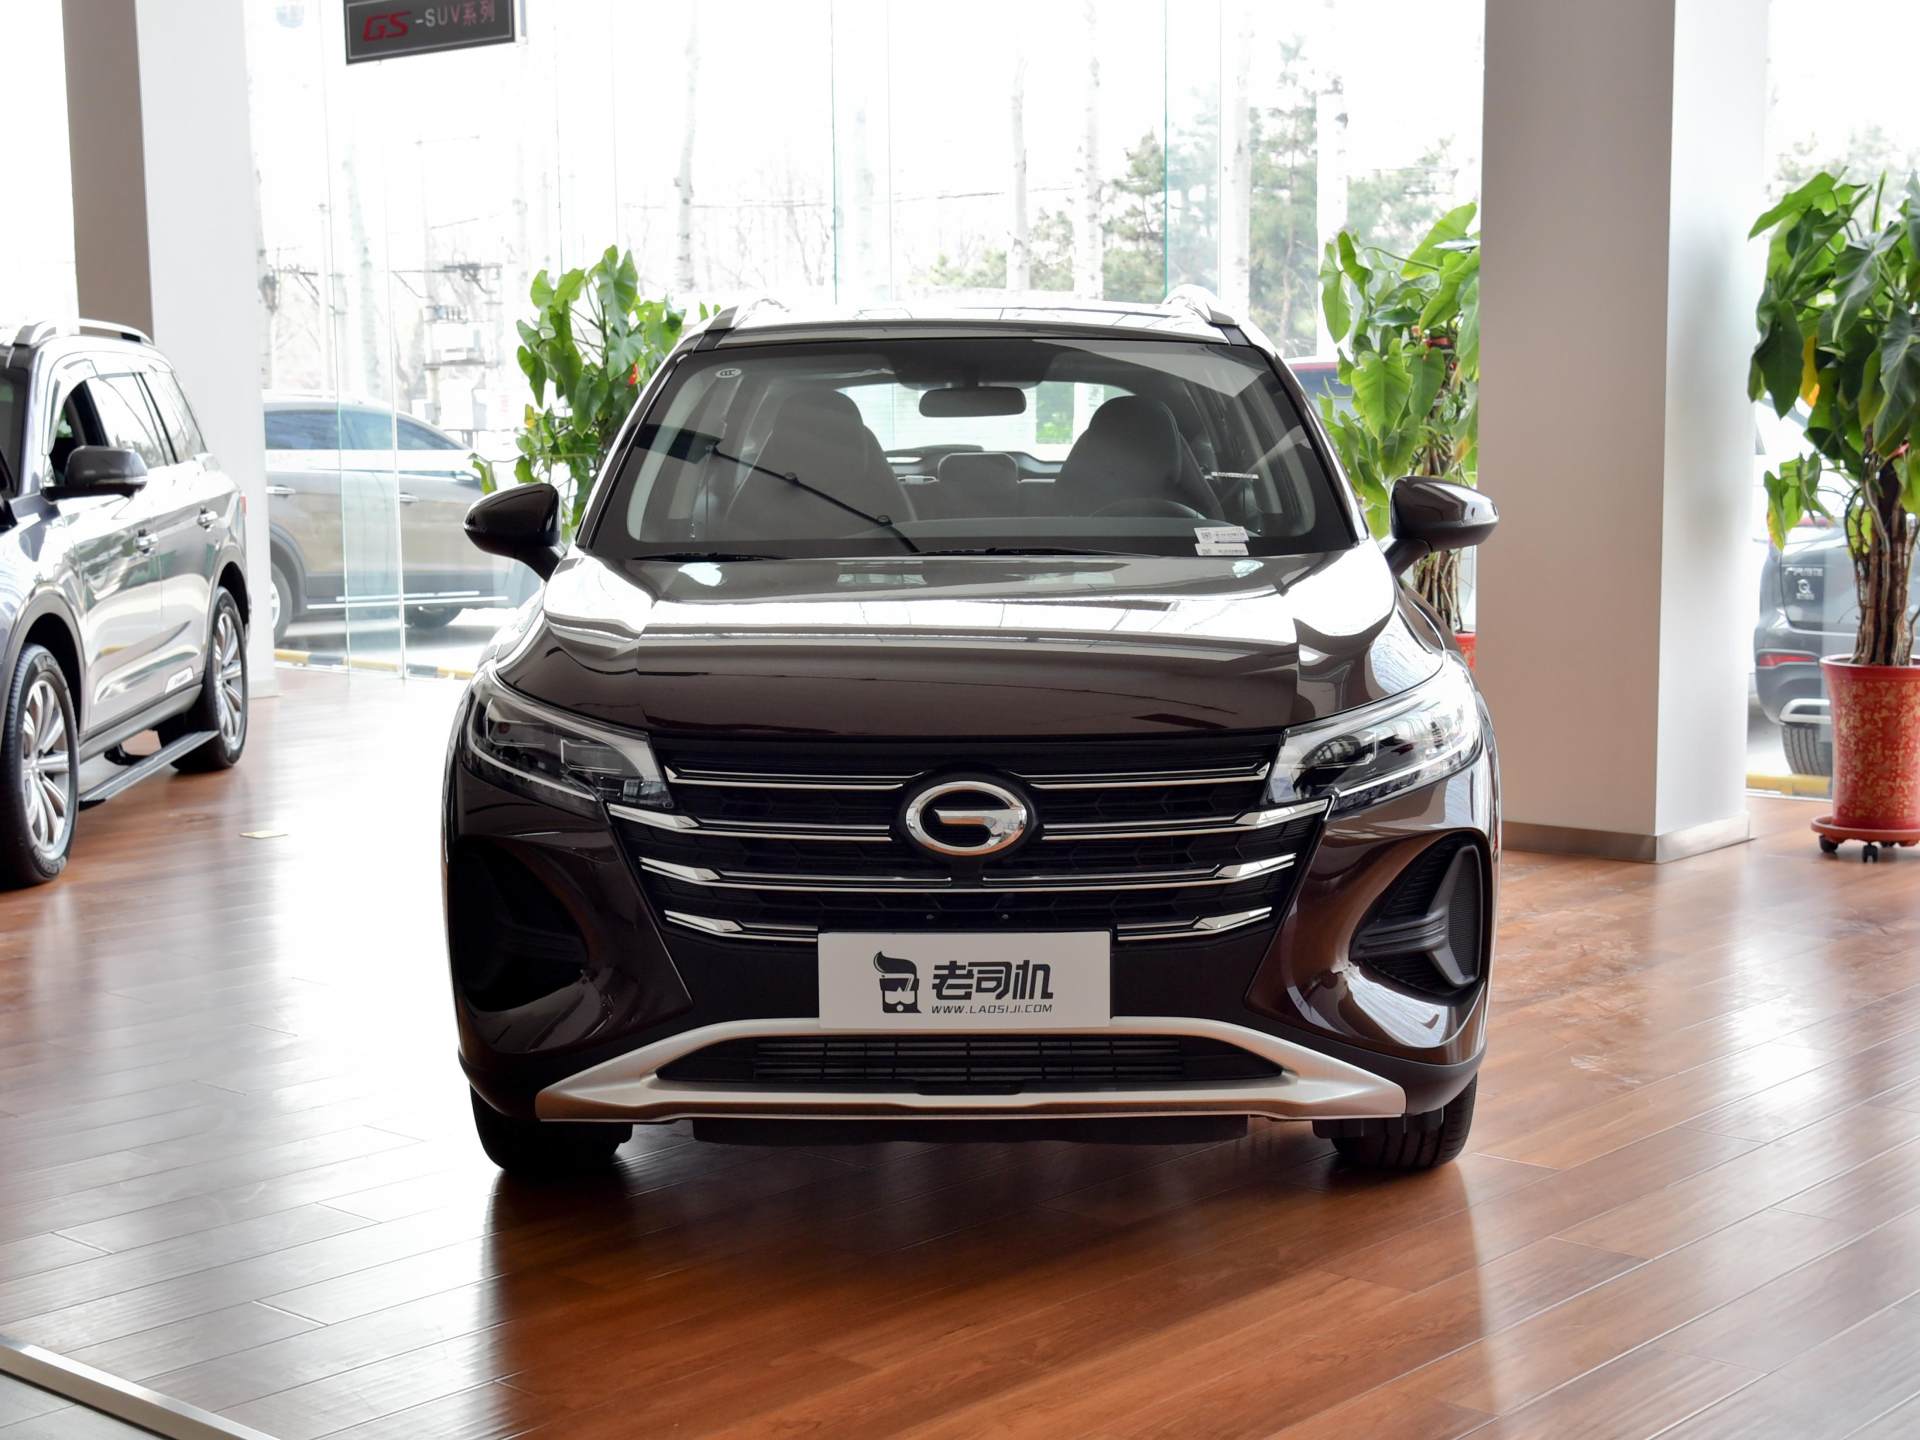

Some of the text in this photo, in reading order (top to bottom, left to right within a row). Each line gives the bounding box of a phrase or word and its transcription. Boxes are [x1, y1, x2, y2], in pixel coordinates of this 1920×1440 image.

[362, 11, 412, 42] GS
[931, 959, 1054, 1000] 老司机
[931, 1004, 1053, 1014] WWW.LAOSIJI.COM
